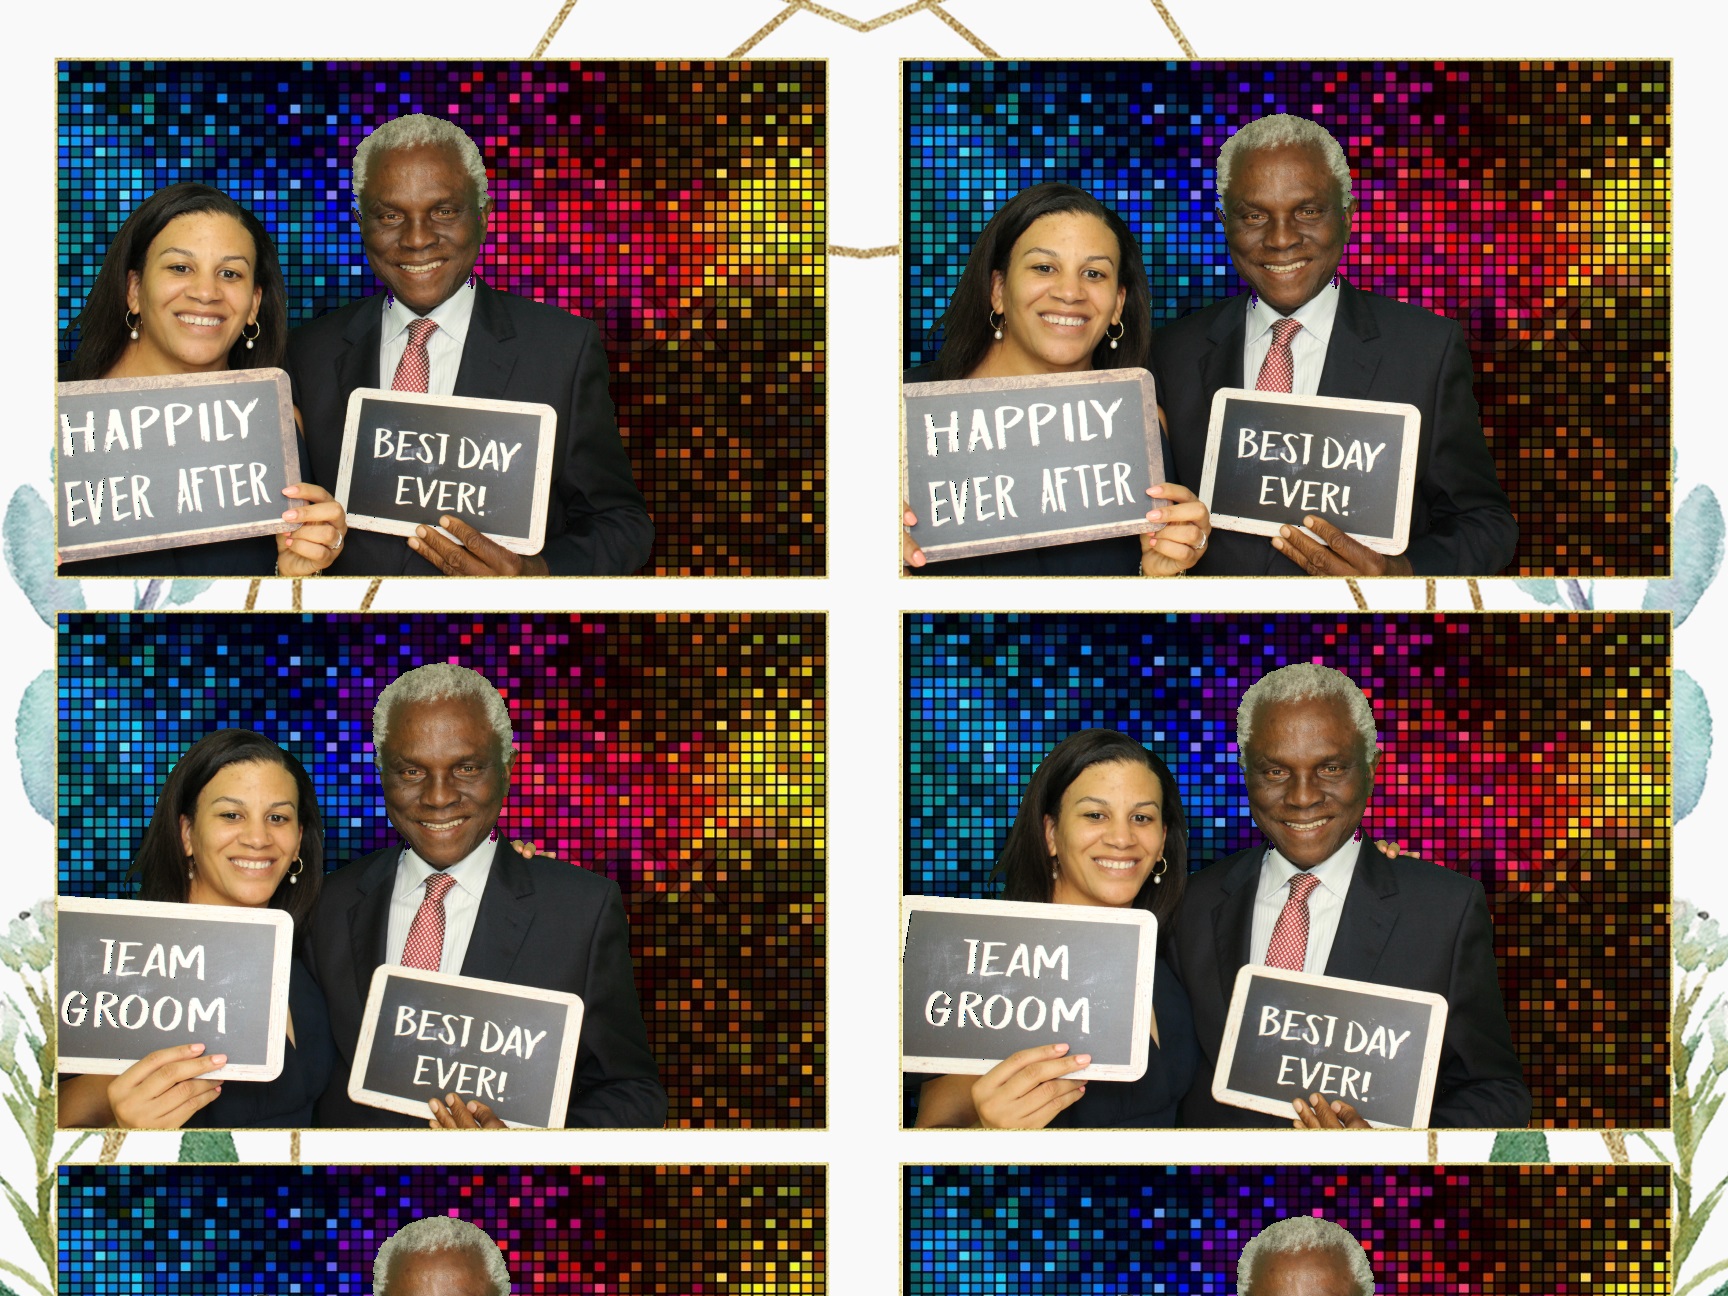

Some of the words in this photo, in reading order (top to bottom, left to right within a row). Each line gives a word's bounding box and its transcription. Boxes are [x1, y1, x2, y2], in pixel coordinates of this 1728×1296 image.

[60, 398, 258, 457] HAPPILY
[374, 428, 449, 464] BEST
[458, 437, 522, 472] DAY
[924, 398, 1123, 457] HAPPILY
[1238, 428, 1313, 464] BEST
[1322, 437, 1386, 472] DAY
[66, 475, 154, 528] EVER
[177, 462, 272, 514] AFTER
[396, 476, 486, 517] EVER!
[930, 475, 1018, 528] EVER
[1041, 462, 1136, 514] AFTER
[1260, 476, 1350, 517] EVER!
[100, 939, 205, 981] TEAM
[964, 939, 1069, 981] TEAM
[61, 991, 228, 1034] GROOM
[395, 1006, 474, 1047] BEST
[480, 1021, 547, 1059] DAY
[925, 991, 1092, 1034] GROOM
[1259, 1006, 1338, 1047] BEST
[1344, 1021, 1411, 1059] DAY
[412, 1056, 507, 1103] EVER!
[1276, 1056, 1371, 1103] EVER!
